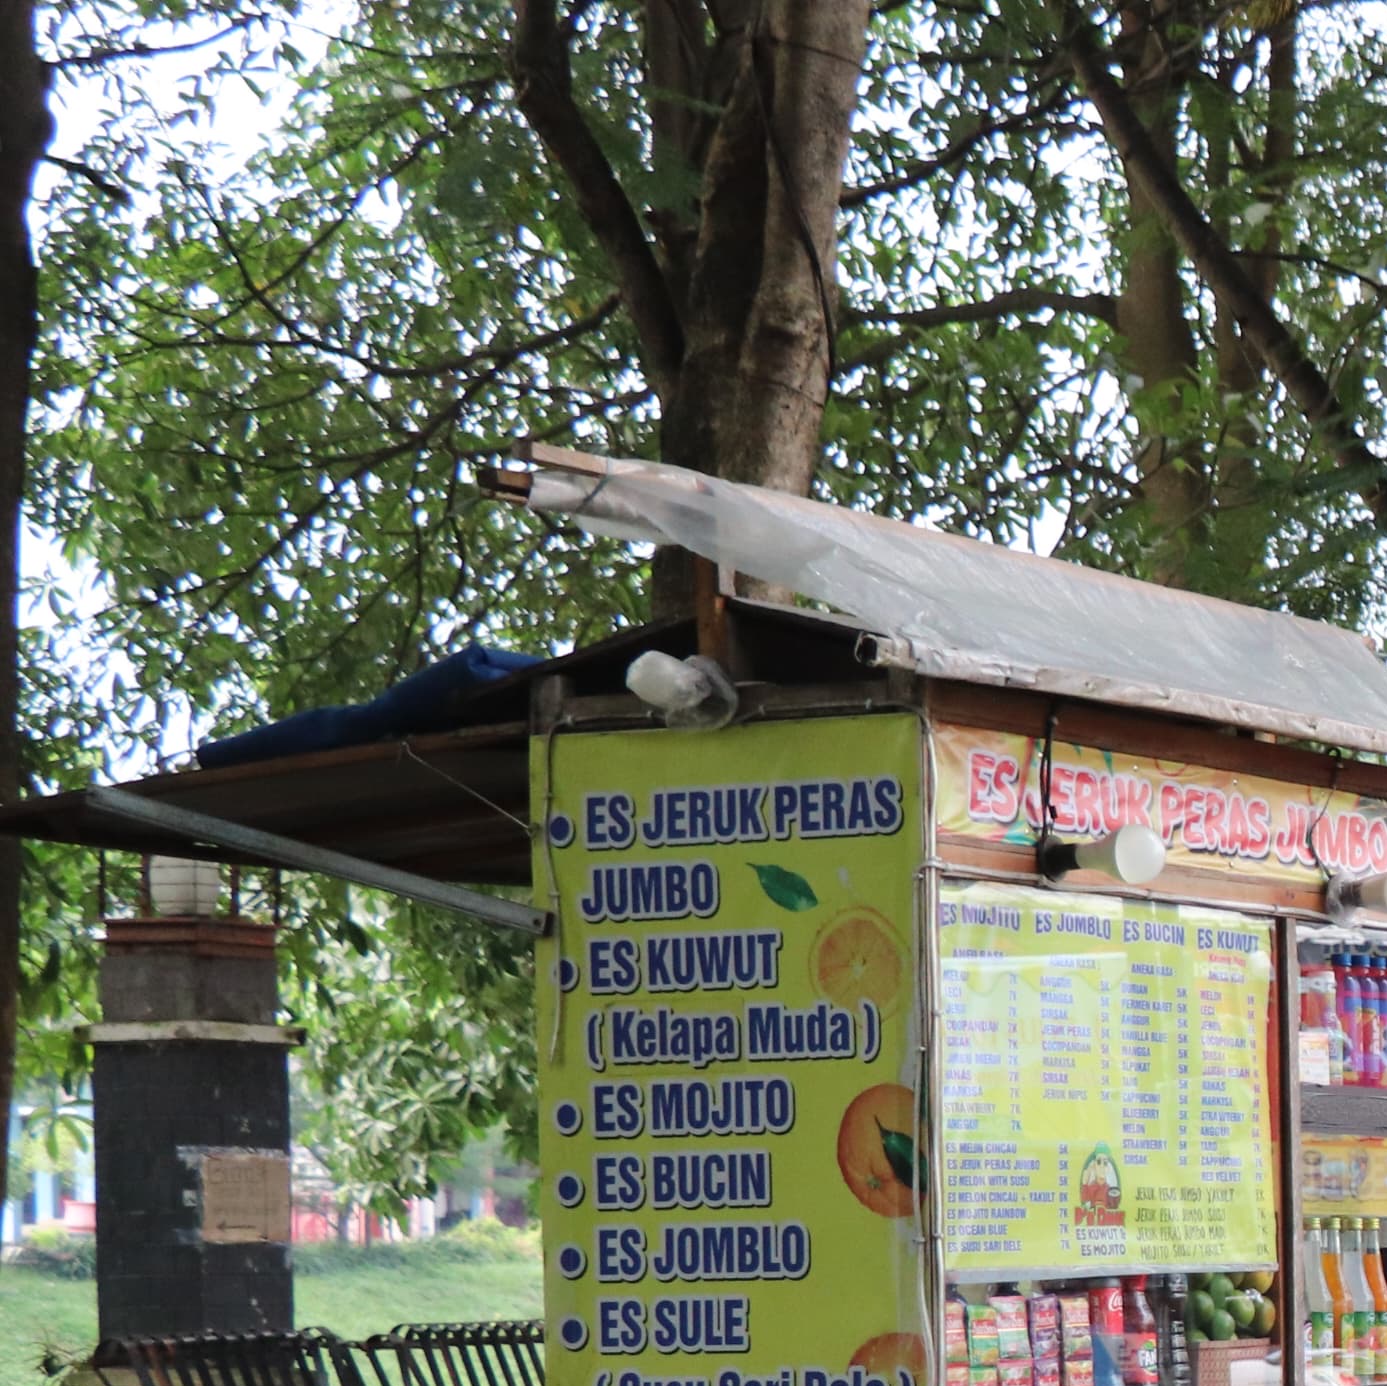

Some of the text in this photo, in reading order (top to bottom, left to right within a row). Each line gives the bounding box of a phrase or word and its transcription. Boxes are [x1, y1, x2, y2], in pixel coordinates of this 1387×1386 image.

[586, 778, 898, 844] ES JERUK PERAS
[970, 753, 1017, 820] ES
[1026, 768, 1152, 832] JERUK
[1162, 781, 1269, 857] PERAS
[582, 863, 714, 917] JUMBO
[589, 933, 777, 988] ES KUWUT
[593, 1078, 789, 1133] ES MOJITO
[598, 1153, 766, 1203] ES BUCIN
[598, 1224, 805, 1278] ES JOMBLO
[600, 1298, 746, 1348] ES SULE
